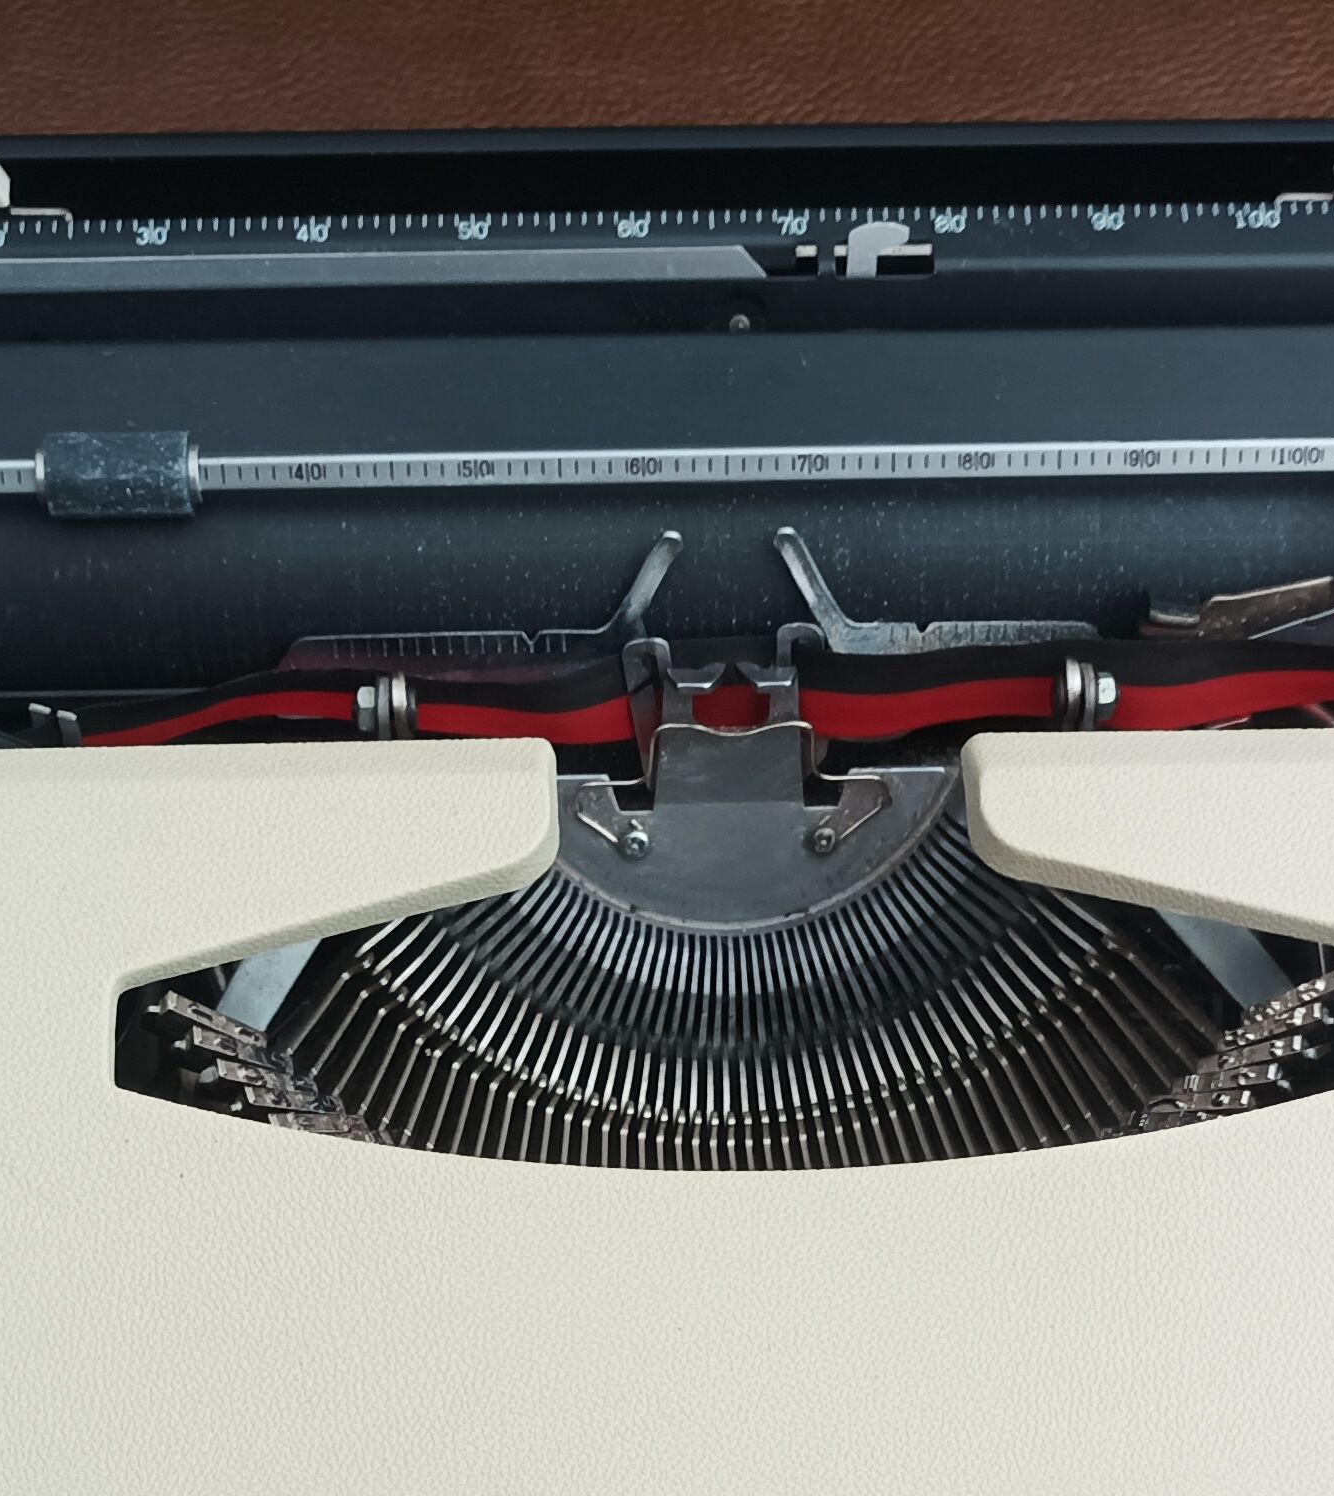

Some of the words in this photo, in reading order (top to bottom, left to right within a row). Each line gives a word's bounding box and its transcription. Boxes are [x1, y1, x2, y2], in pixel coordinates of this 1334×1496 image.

[135, 226, 168, 246] 30
[295, 222, 329, 243] 40
[457, 219, 489, 240] 50
[617, 218, 649, 239] 60
[777, 214, 807, 236] 70
[1234, 210, 1281, 230] 100
[294, 463, 323, 482] 40
[461, 460, 492, 481] 50
[629, 456, 658, 476] 60
[797, 454, 824, 474] 70
[963, 451, 992, 471] 80
[1129, 447, 1156, 468] 90
[1279, 447, 1320, 465] 100
